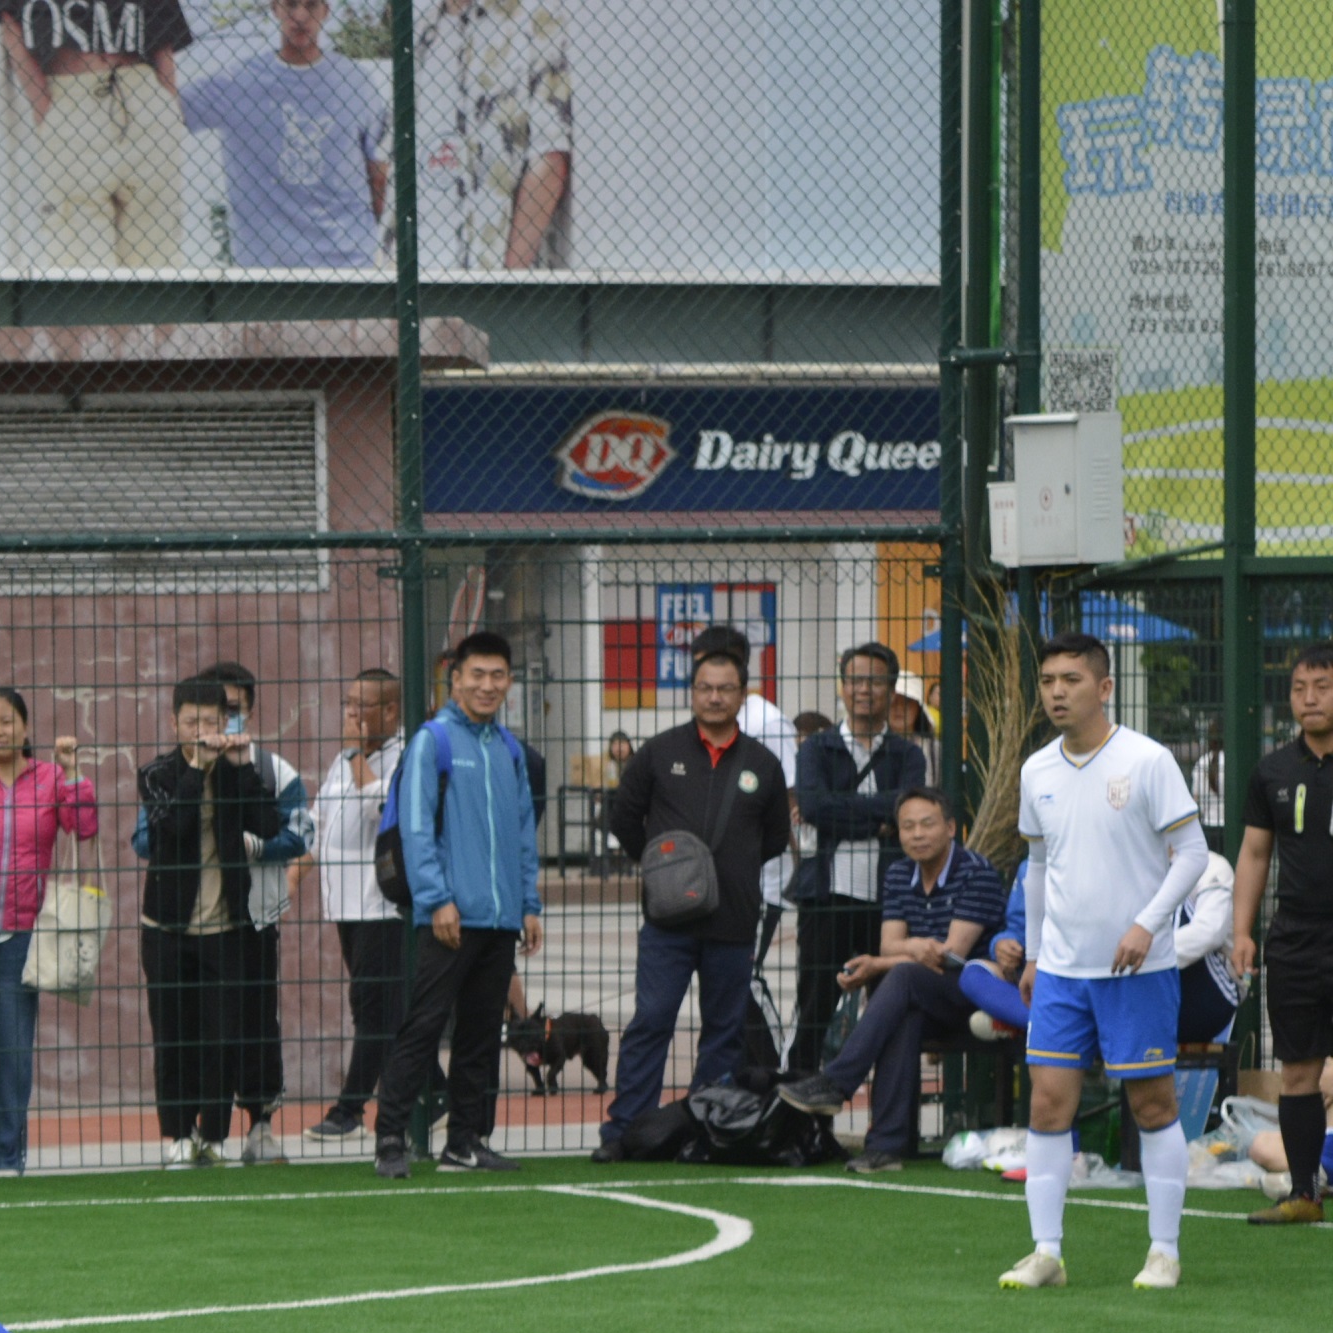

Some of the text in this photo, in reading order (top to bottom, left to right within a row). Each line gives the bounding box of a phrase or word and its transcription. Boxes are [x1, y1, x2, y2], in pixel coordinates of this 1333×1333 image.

[582, 429, 942, 480] DQ Dairy Quee
[660, 593, 711, 620] FEEL
[659, 648, 692, 680] FU
